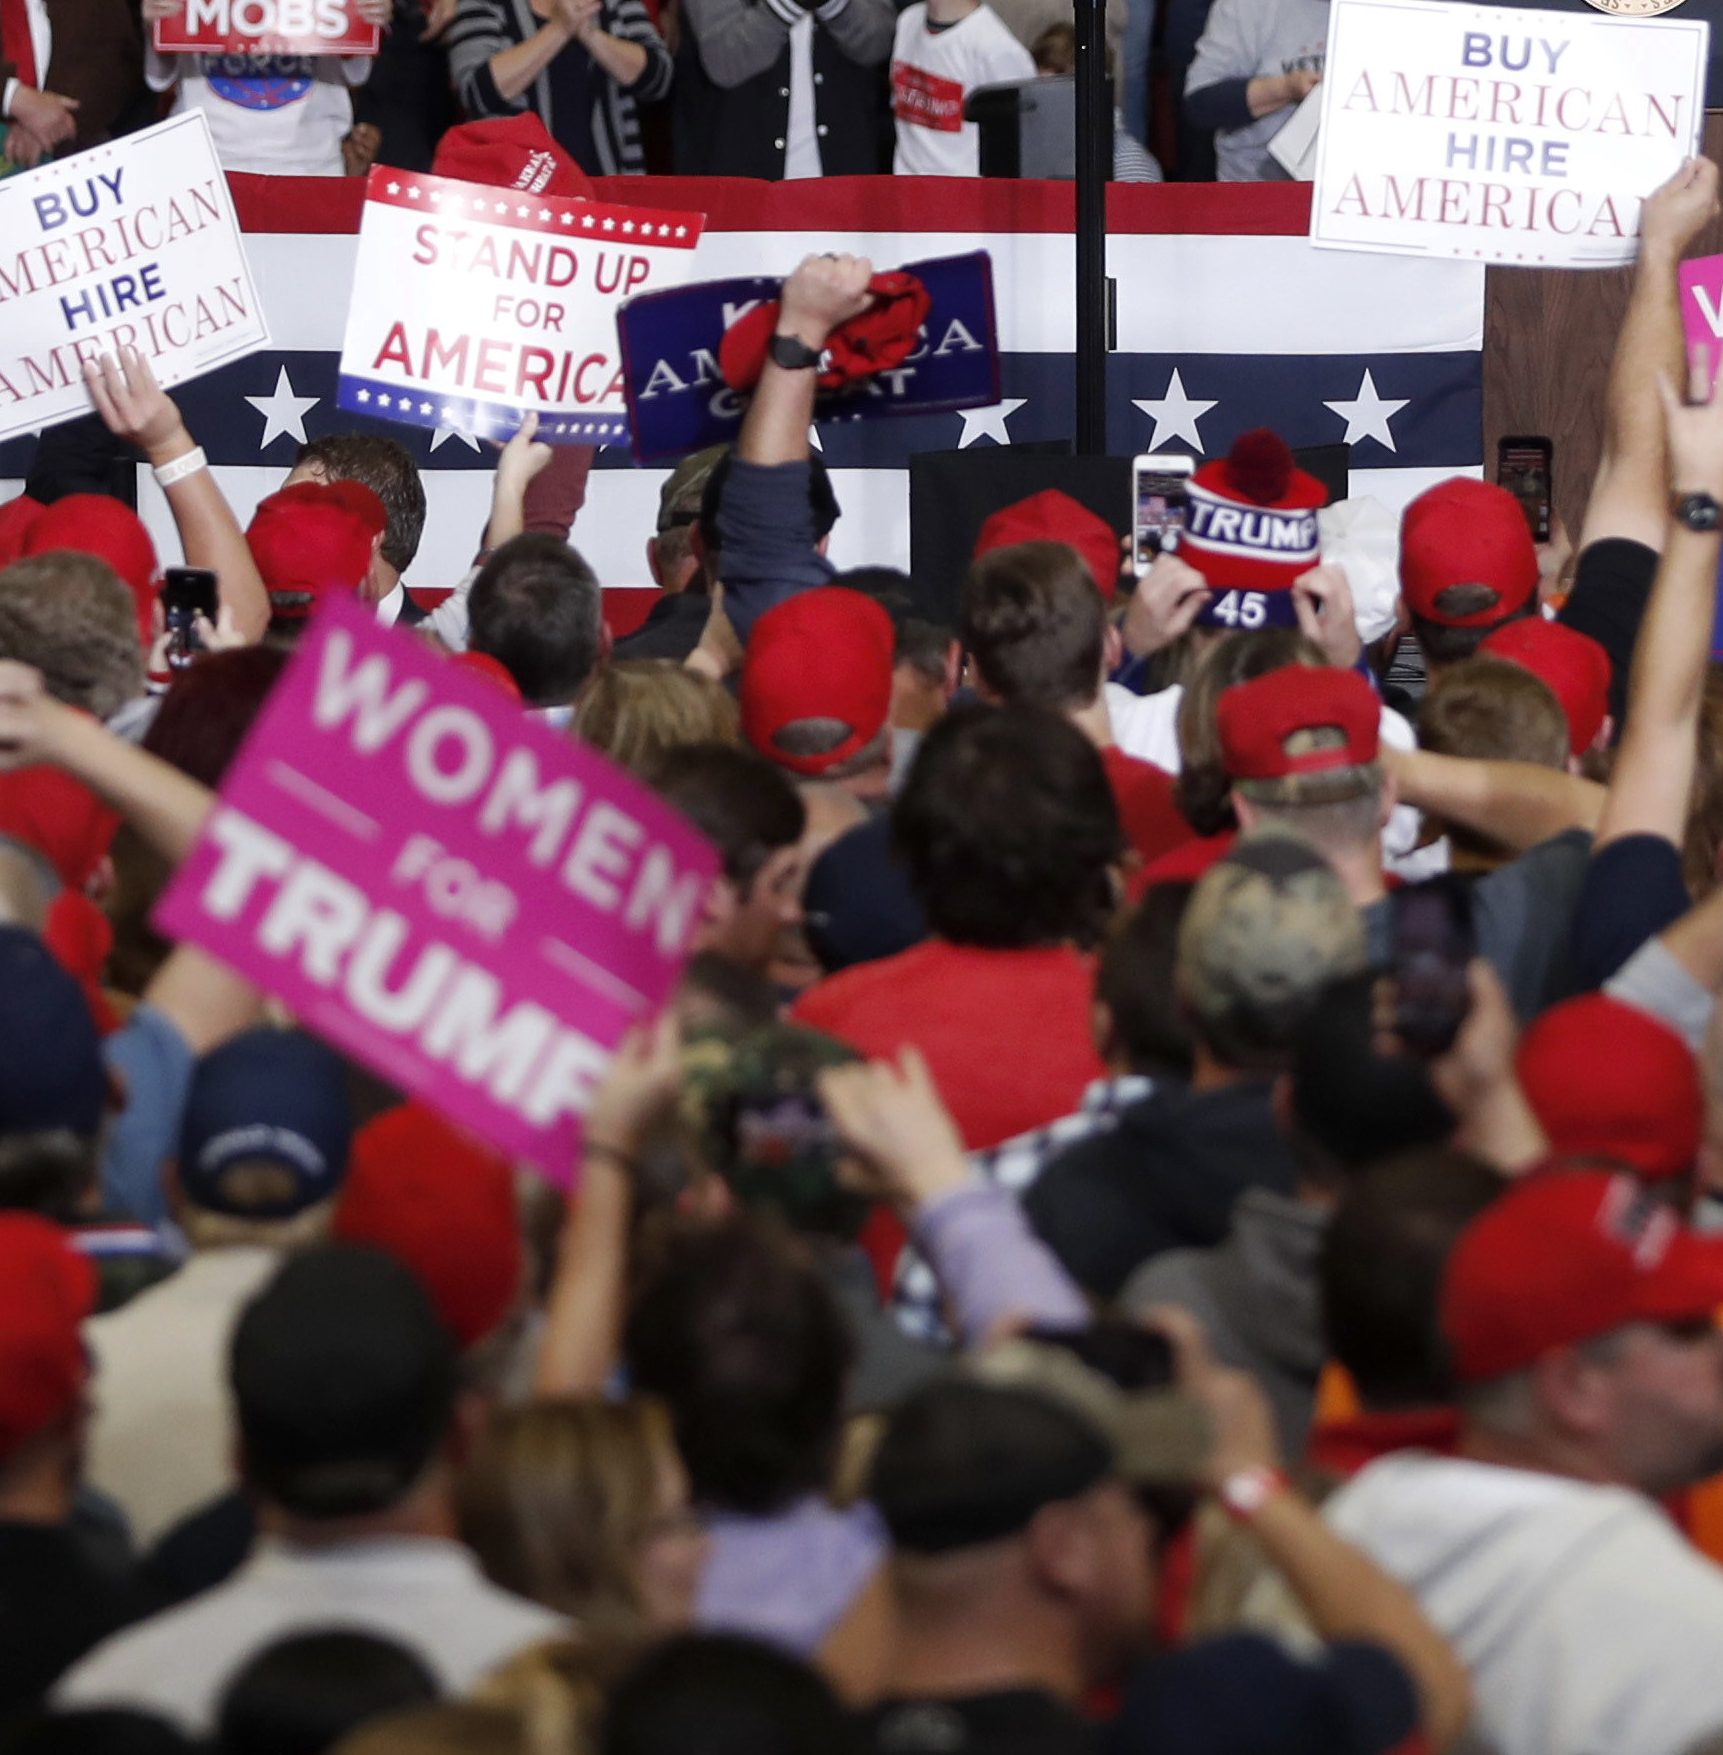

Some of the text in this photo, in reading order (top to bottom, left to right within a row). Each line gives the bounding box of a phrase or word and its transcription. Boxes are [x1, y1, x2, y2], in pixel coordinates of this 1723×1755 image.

[1461, 32, 1570, 74] BUY
[1340, 69, 1683, 138] AMERICAN
[1445, 132, 1569, 177] HIRE
[32, 167, 126, 232] BUY
[412, 223, 650, 297] STAND UP
[59, 262, 167, 331] HIRE
[492, 293, 566, 334] FOR
[372, 318, 626, 414] AMERICA
[1190, 502, 1317, 549] TRUMP
[1213, 590, 1266, 627] 45
[309, 632, 703, 956] WOMEN
[394, 834, 517, 942] FOR
